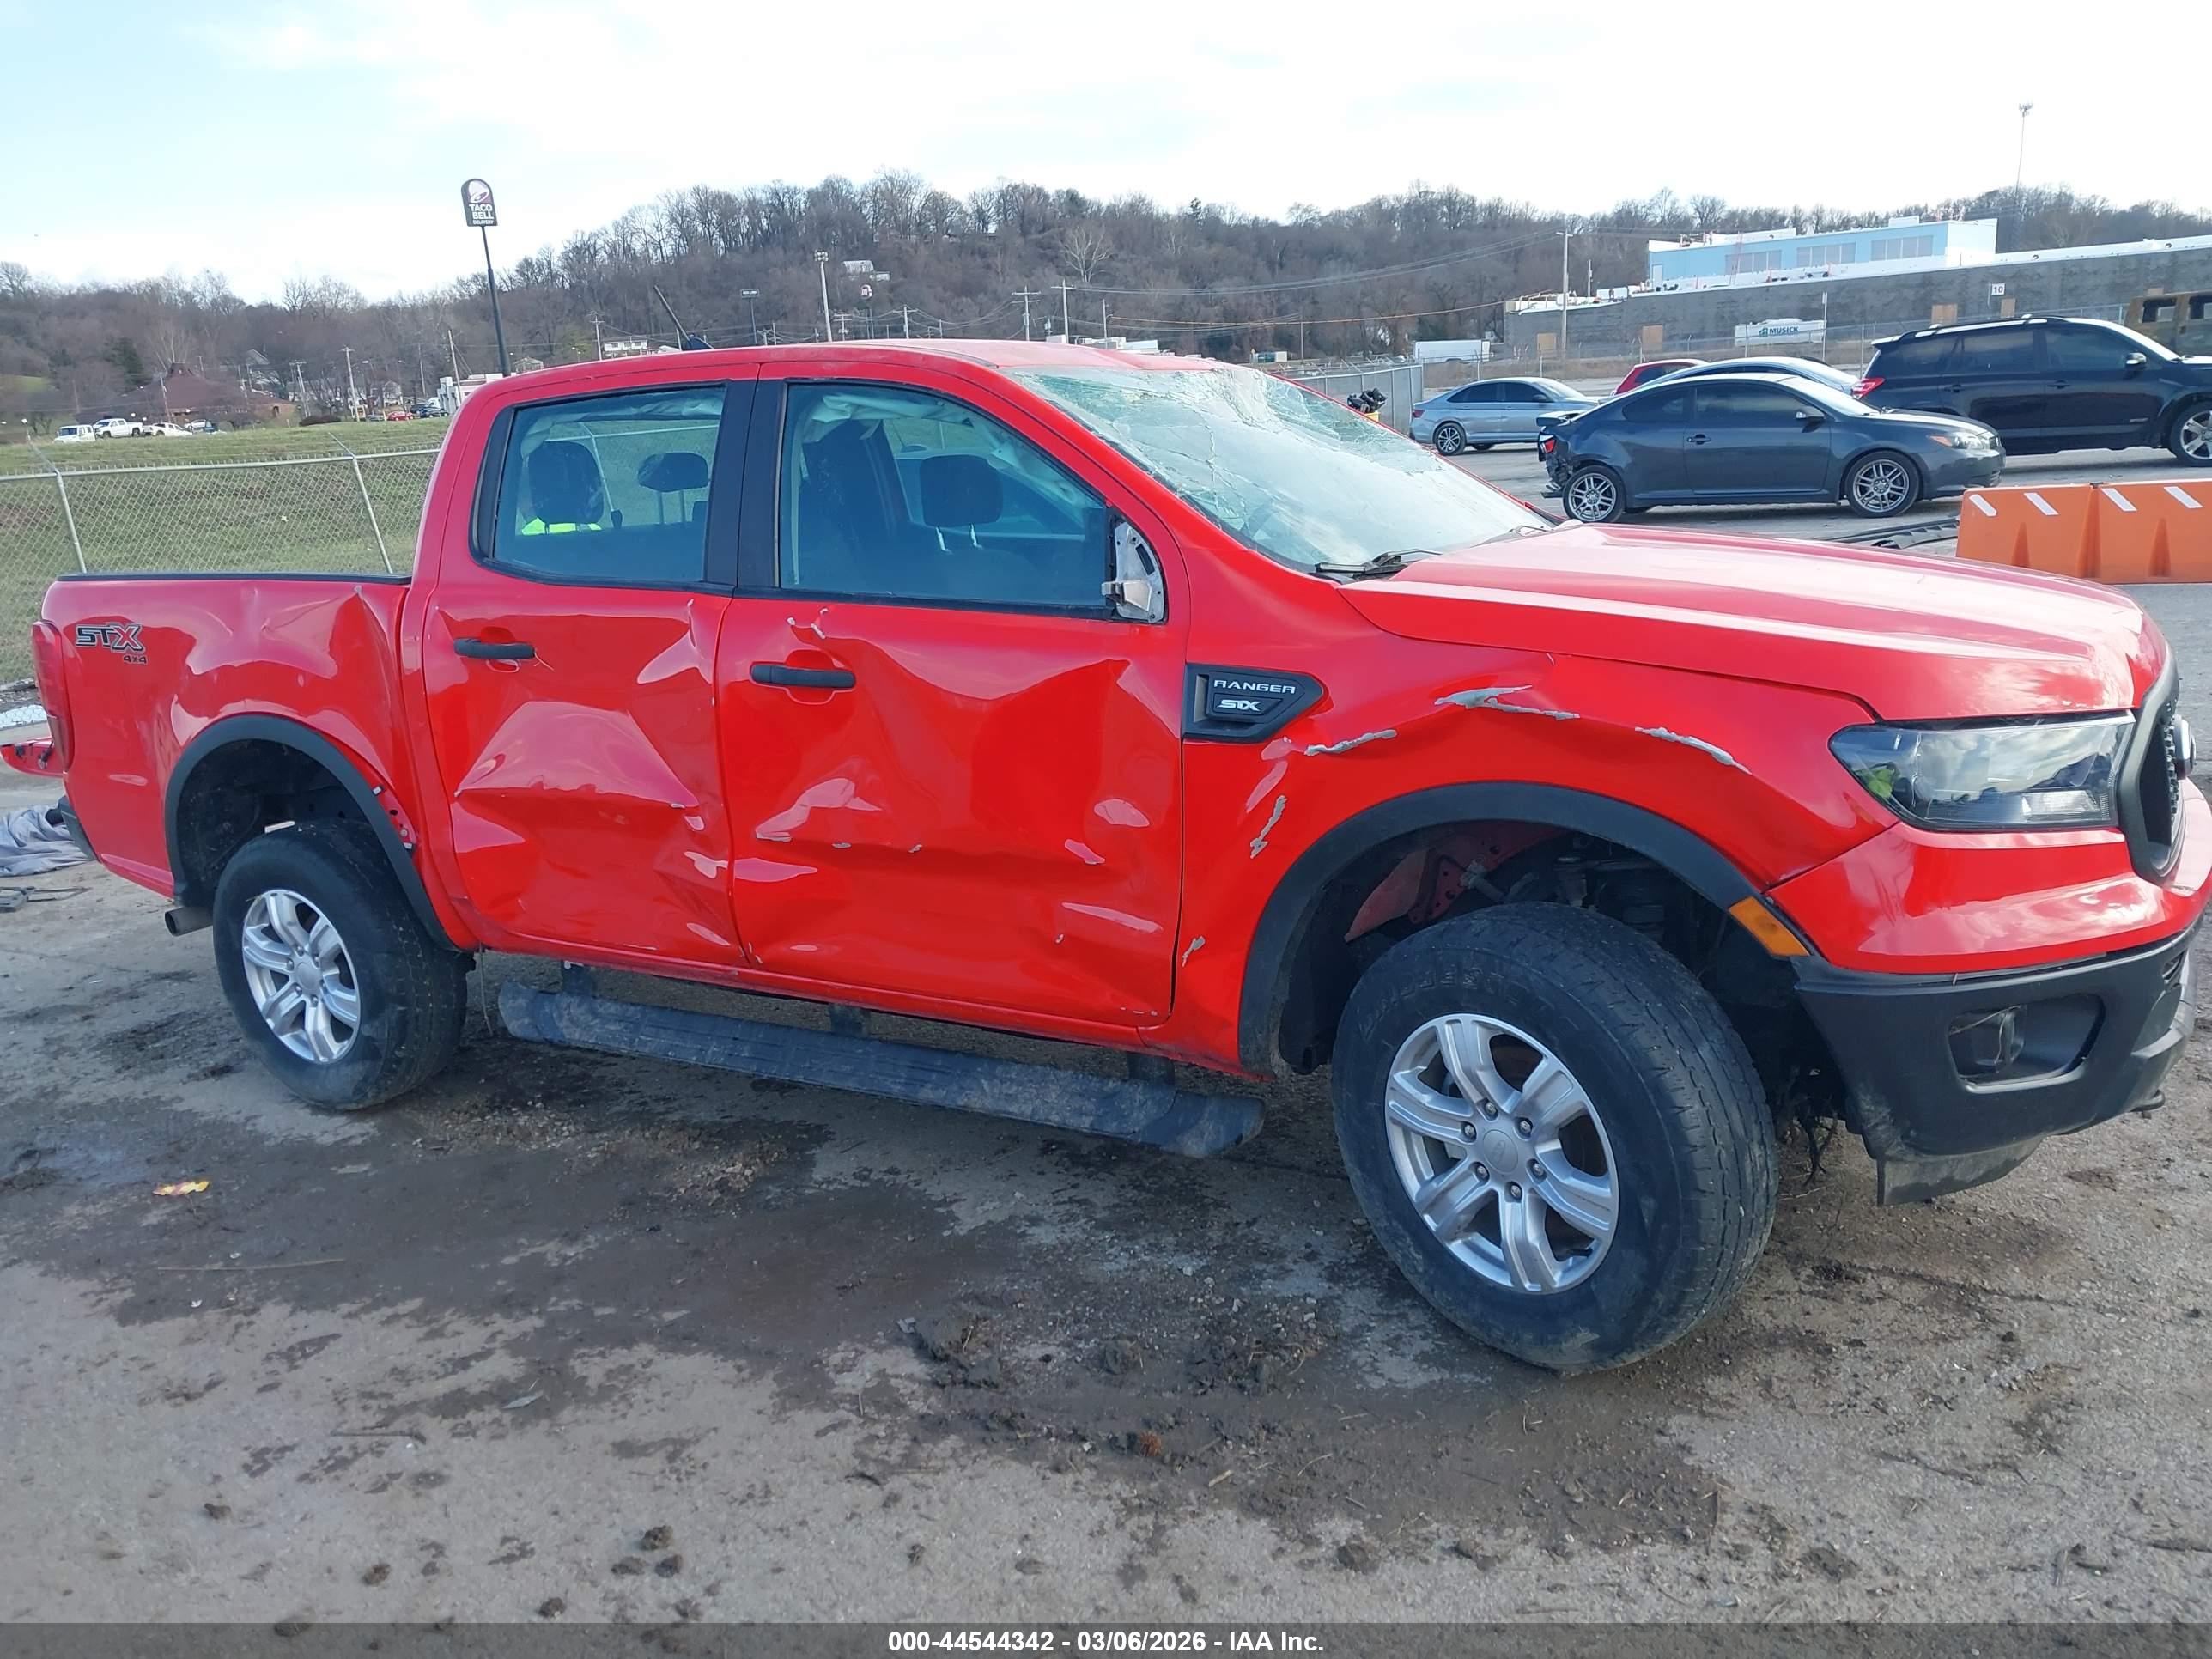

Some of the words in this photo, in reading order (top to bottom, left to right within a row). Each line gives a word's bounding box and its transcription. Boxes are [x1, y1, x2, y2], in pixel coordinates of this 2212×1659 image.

[473, 211, 495, 220] BELL
[1769, 326, 1800, 335] MUSICK
[76, 623, 143, 651] STX
[1214, 679, 1296, 694] RANGER
[1217, 699, 1261, 712] STX
